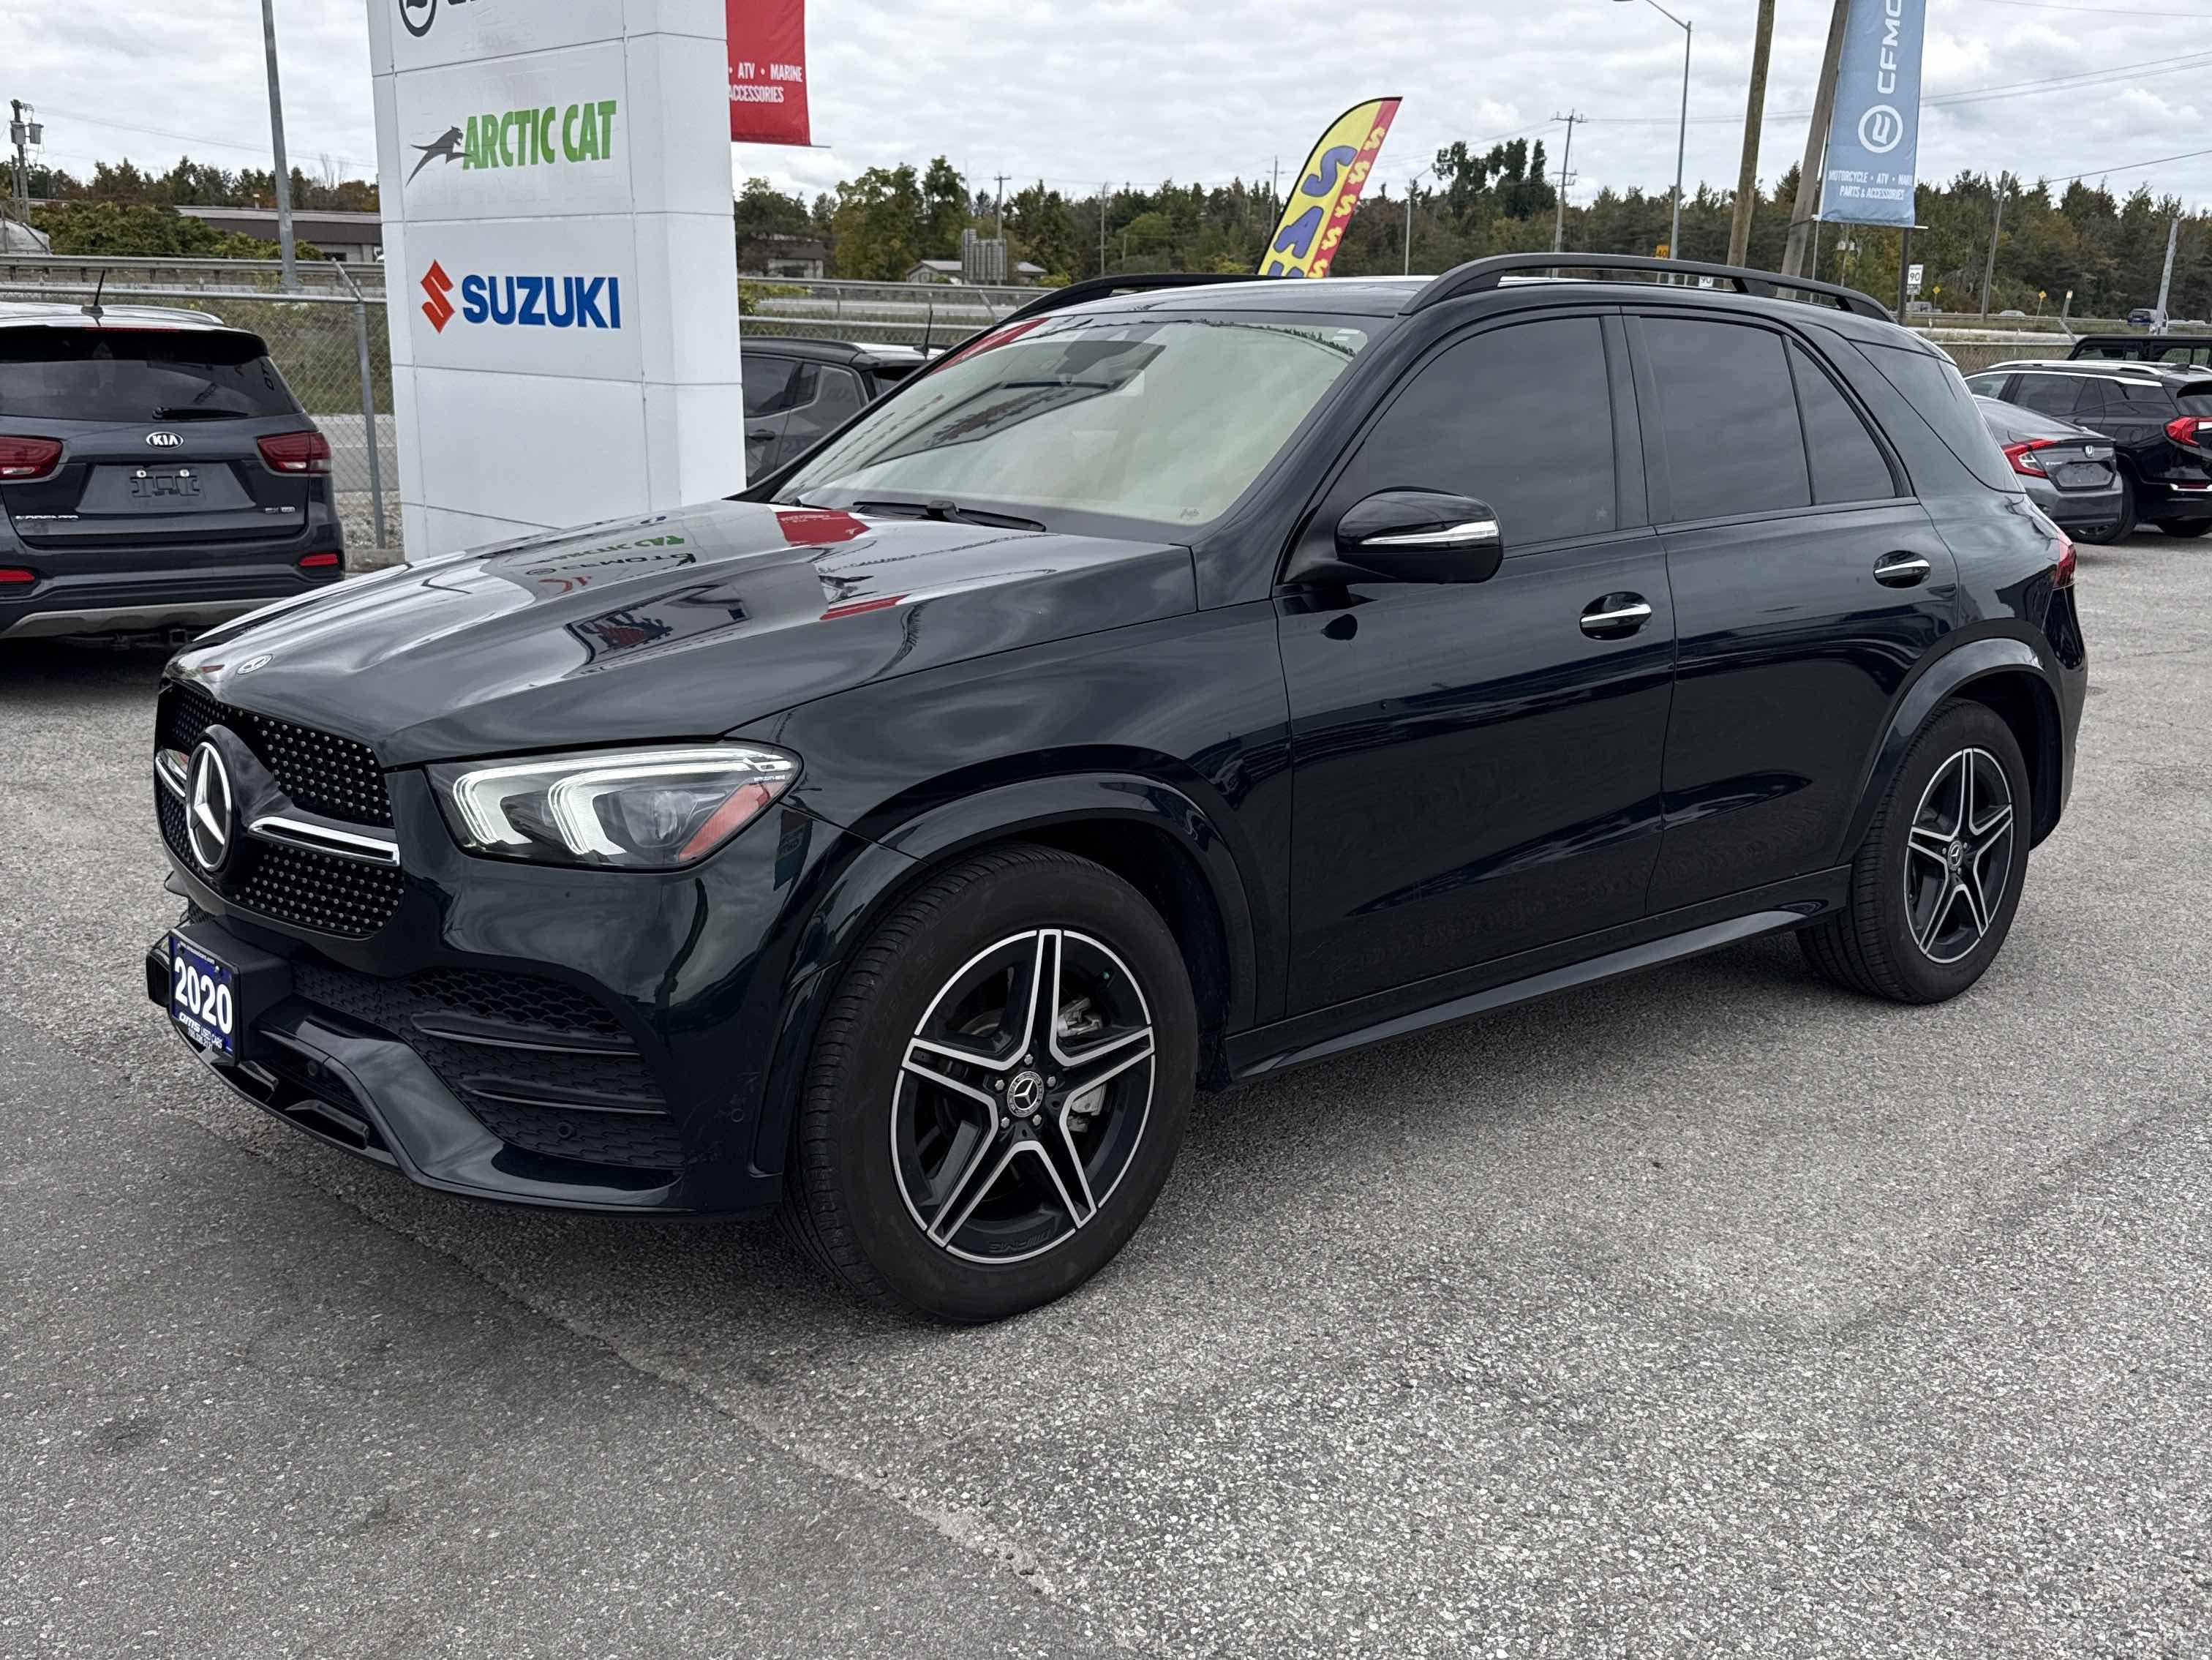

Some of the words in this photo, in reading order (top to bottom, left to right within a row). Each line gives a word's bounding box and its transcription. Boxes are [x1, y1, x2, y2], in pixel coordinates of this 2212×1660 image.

[737, 62, 756, 79] ATV
[770, 63, 803, 83] MARINE
[462, 106, 556, 170] ARCTIC
[562, 100, 617, 162] CAT
[1828, 169, 1868, 183] MOTORCYCLE
[1876, 172, 1889, 184] ATV
[1839, 184, 1860, 198] PARTS
[1865, 187, 1905, 200] ACCESSORIES
[1909, 272, 1920, 281] 90
[462, 274, 621, 329] SUZUKI
[152, 435, 178, 446] KIA
[174, 956, 233, 1034] 2020
